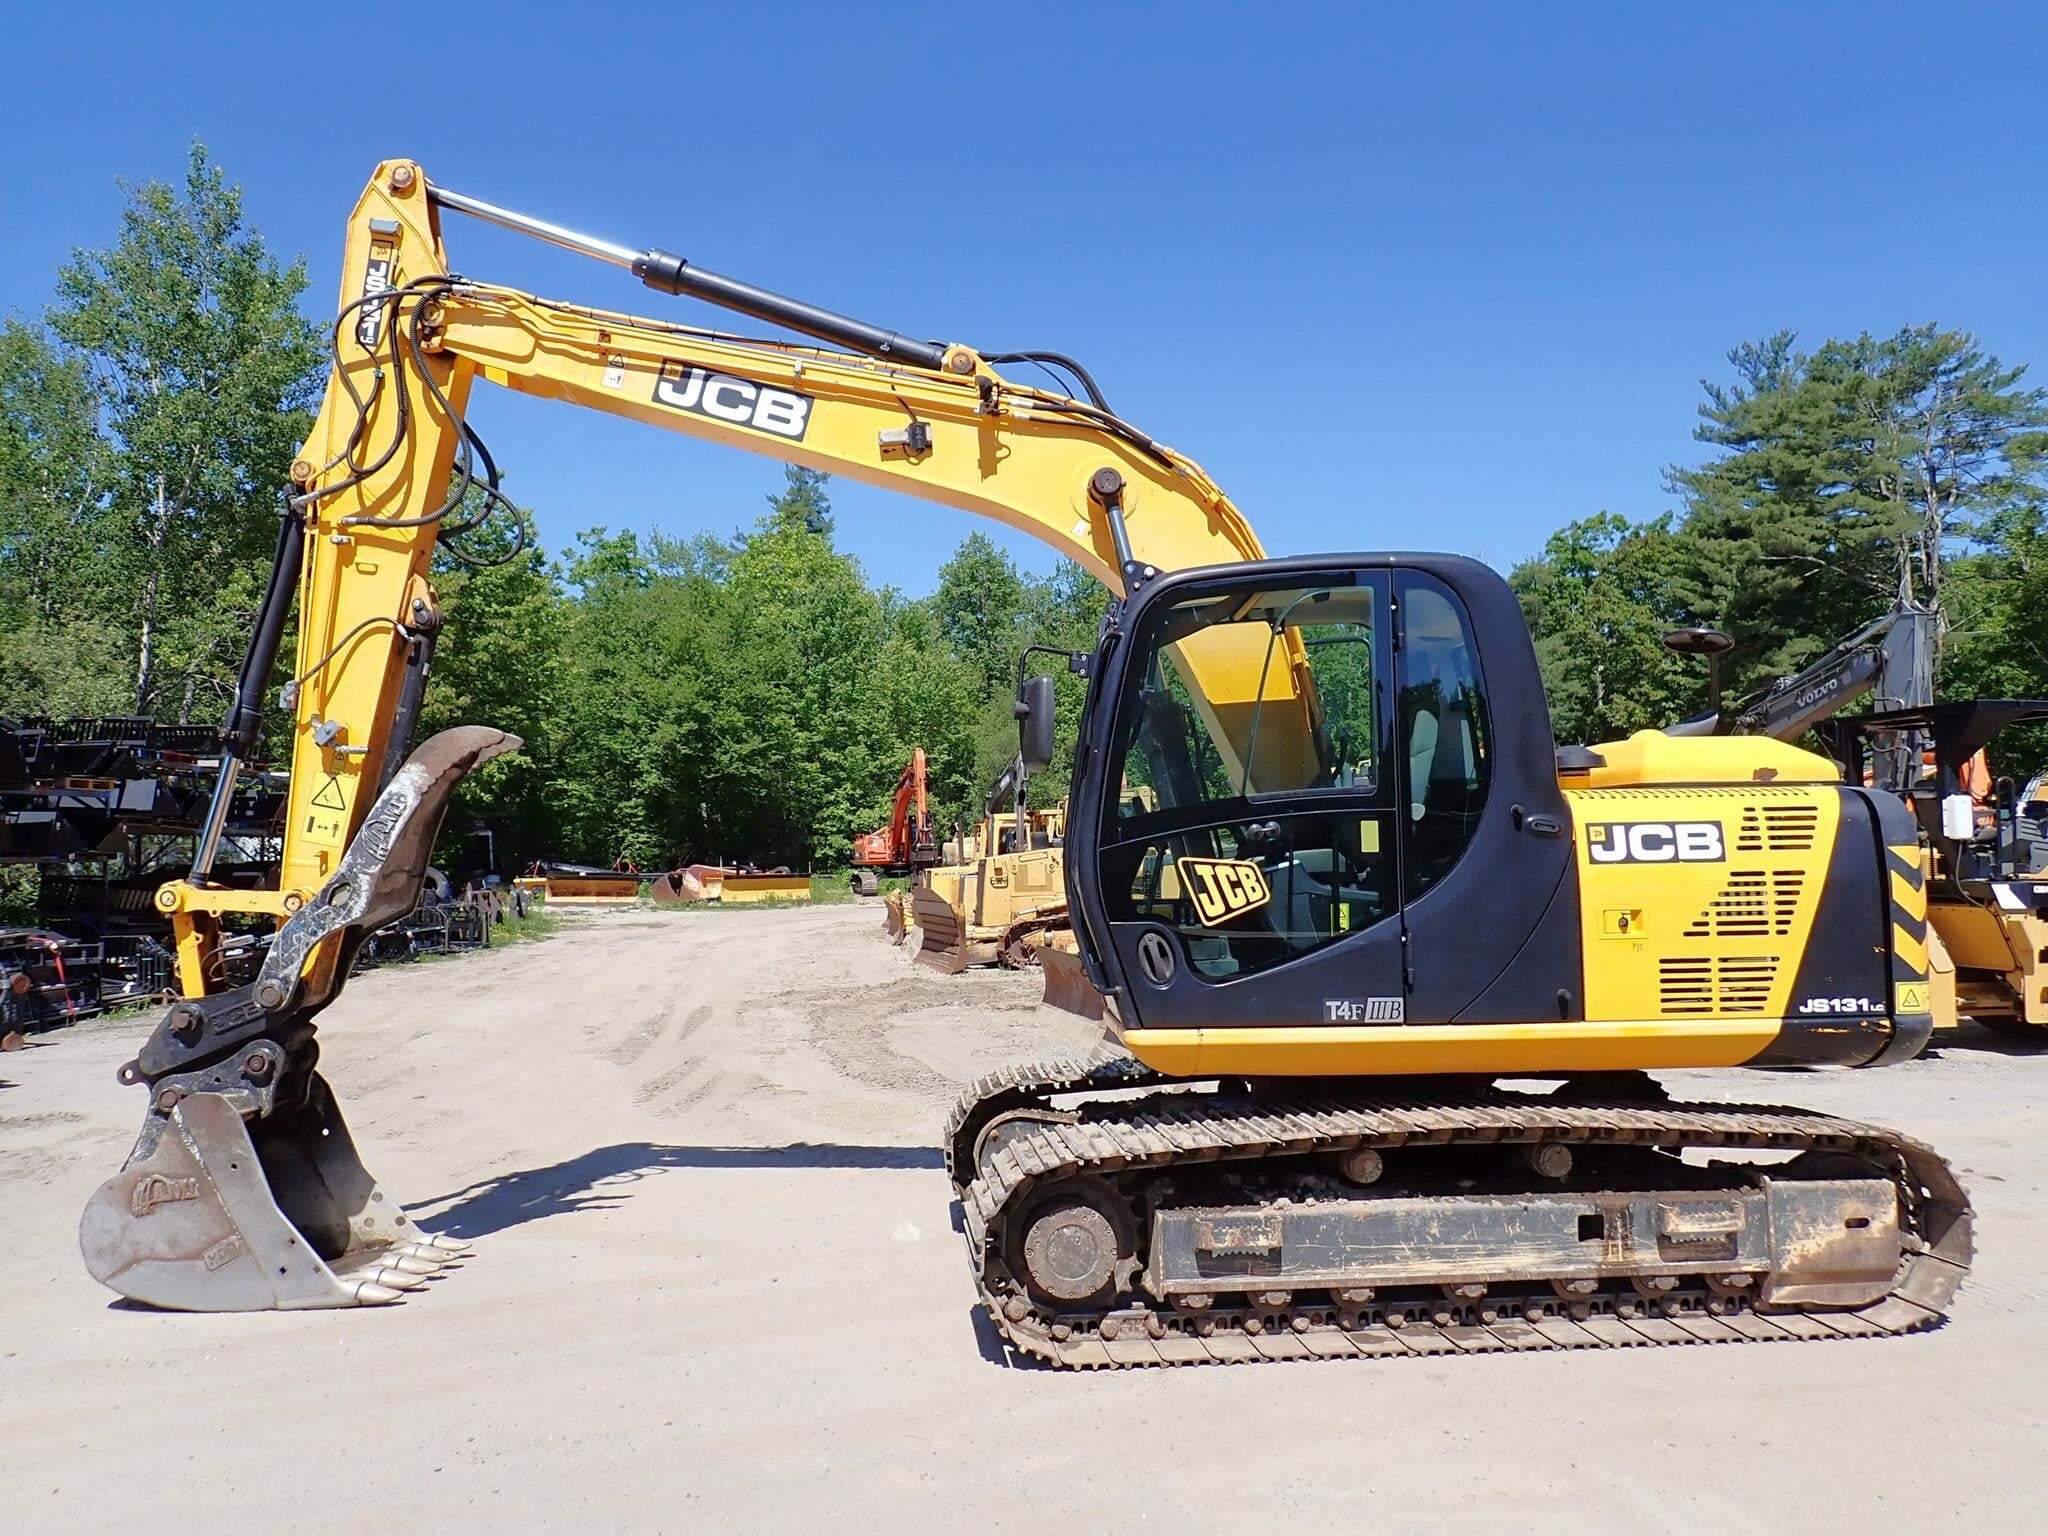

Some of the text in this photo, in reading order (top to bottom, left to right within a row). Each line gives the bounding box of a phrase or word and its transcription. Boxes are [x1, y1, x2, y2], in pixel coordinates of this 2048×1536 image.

[658, 368, 808, 436] JCB
[1796, 679, 1838, 707] VOLVO
[1590, 824, 1723, 861] JCB
[1194, 864, 1264, 917] JCB
[1325, 1001, 1364, 1020] T4F
